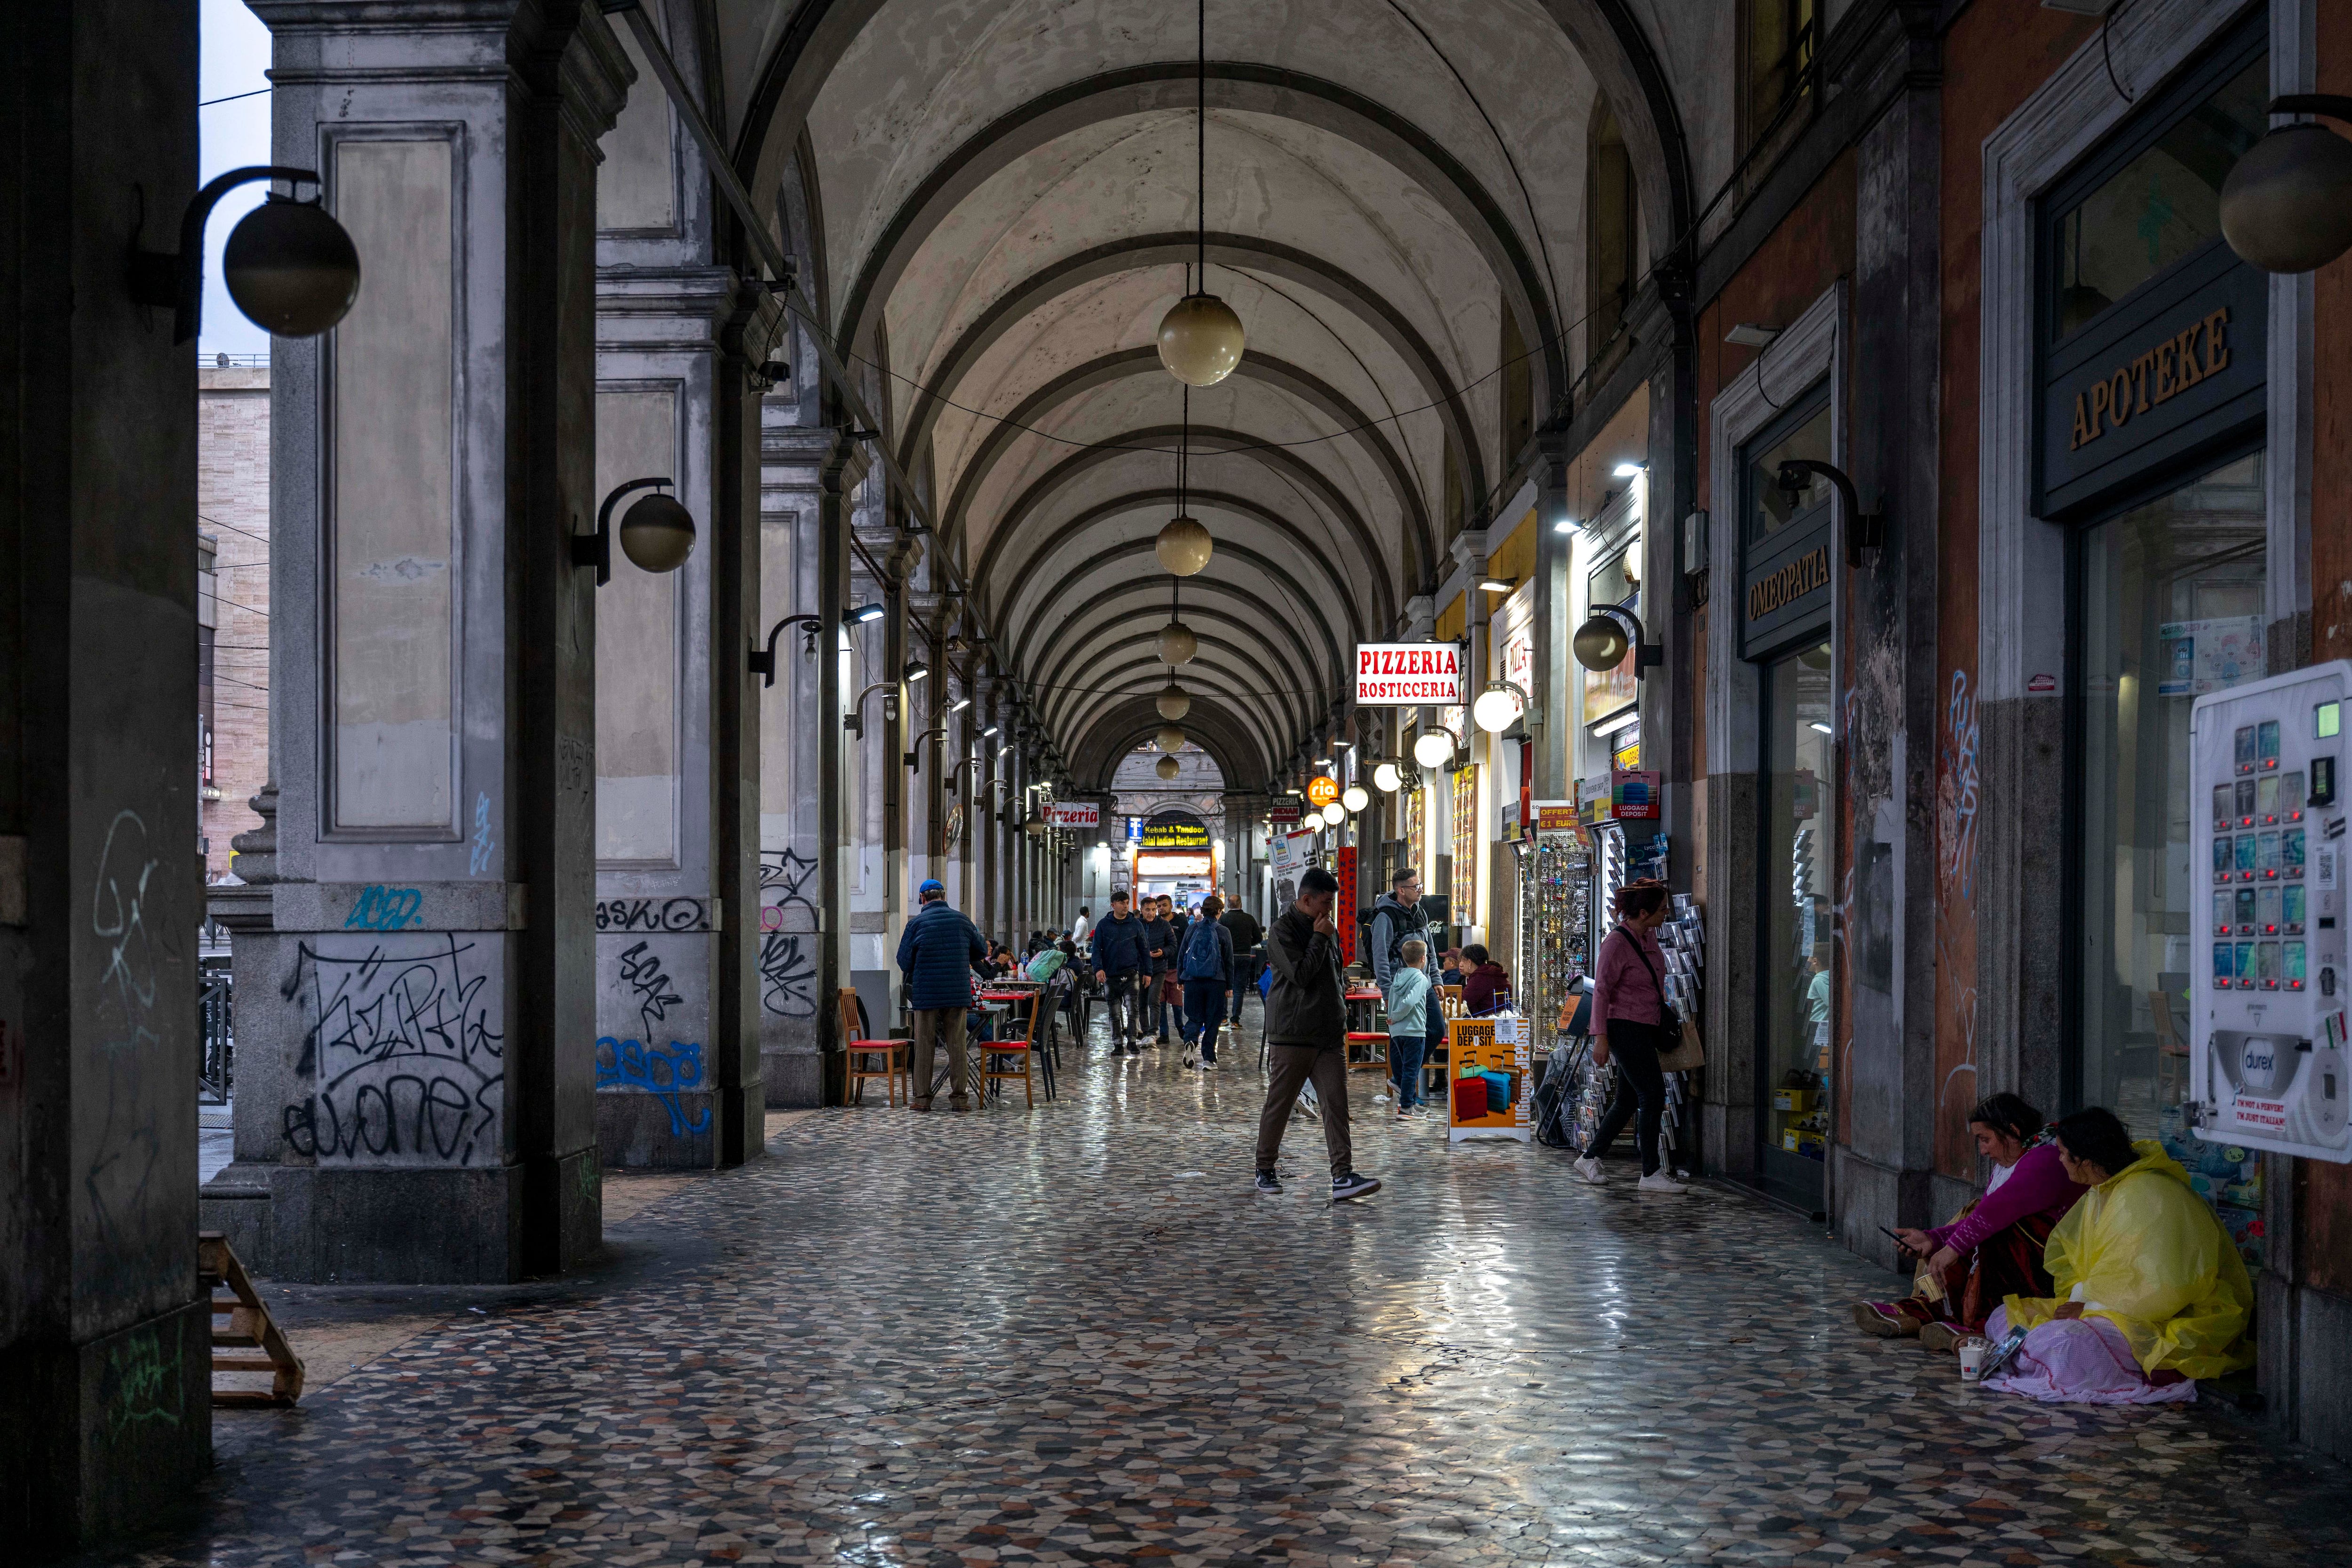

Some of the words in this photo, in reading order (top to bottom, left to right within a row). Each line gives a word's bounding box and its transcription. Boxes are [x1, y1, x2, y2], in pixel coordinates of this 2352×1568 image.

[2070, 307, 2228, 452] APOTEKE
[1748, 545, 1829, 621] OMEOPATIA
[1360, 651, 1458, 675] PIZZERIA
[1510, 637, 1526, 677] PIZZA
[1359, 682, 1456, 698] ROSTICCERIA
[1312, 780, 1335, 796] ria
[1586, 784, 1597, 795] SOUVENIR
[1042, 806, 1098, 823] Pizzeria
[1156, 836, 1175, 846] Indian
[1176, 835, 1208, 846] Restaurant
[1457, 1025, 1495, 1036] LUGGAGE
[1457, 1036, 1492, 1046] DEPOSIT
[2246, 1050, 2274, 1071] durex
[2245, 1100, 2255, 1109] NOT
[2261, 1102, 2284, 1113] PERVERT
[2246, 1113, 2259, 1122] JUST
